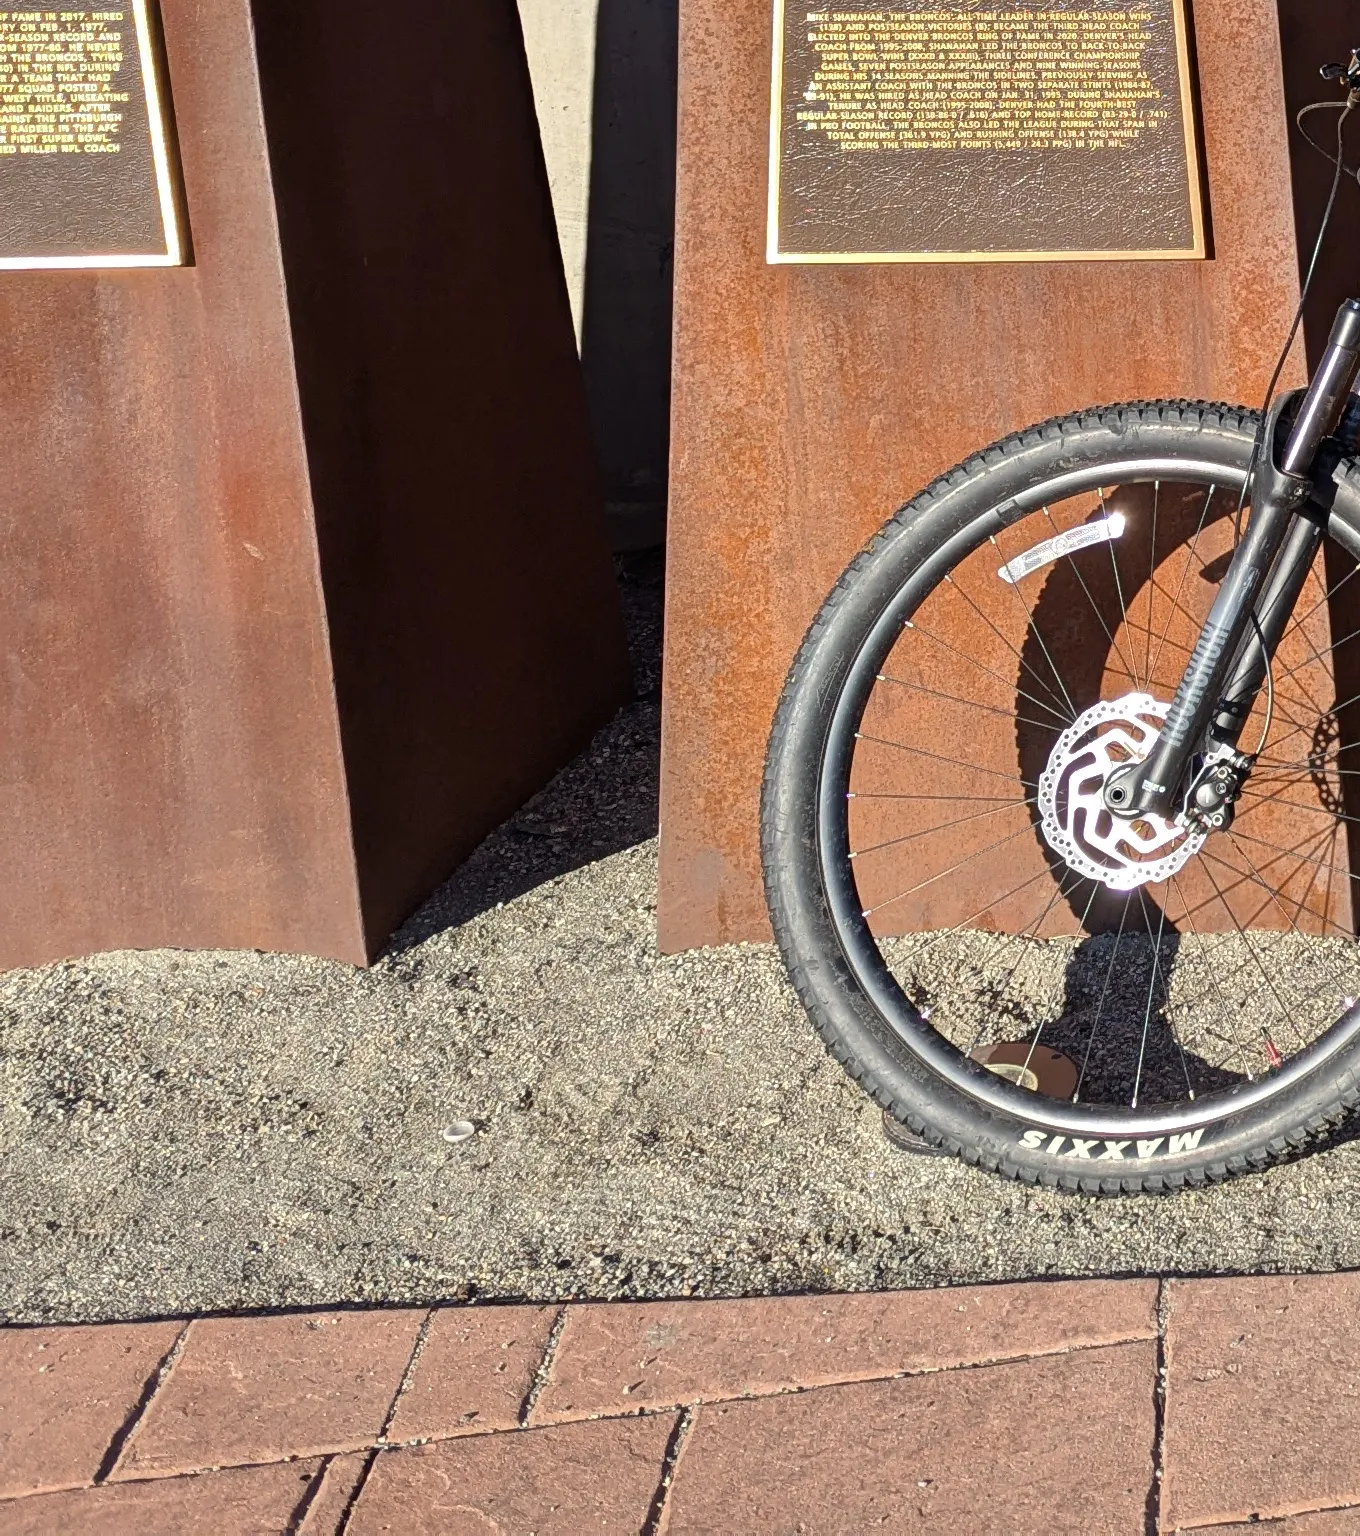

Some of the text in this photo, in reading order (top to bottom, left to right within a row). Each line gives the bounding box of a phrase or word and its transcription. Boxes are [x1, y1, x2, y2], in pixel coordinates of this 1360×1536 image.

[11, 13, 41, 22] FAME
[45, 13, 56, 22] IN
[92, 13, 123, 22] HIRED
[19, 23, 36, 32] ON
[11, 53, 32, 62] THE
[35, 53, 87, 62] BRONCOS,
[91, 53, 123, 62] TYING
[815, 72, 854, 81] DURING
[853, 72, 868, 81] HIS
[871, 72, 881, 80] 14
[885, 72, 924, 80] SEASONS
[927, 72, 970, 80] MANNING
[974, 71, 990, 80] THE
[1041, 70, 1094, 80] PREVIOUSLY
[1097, 70, 1133, 80] SERVING
[1136, 70, 1148, 80] AS
[3, 94, 129, 103] WEST TITLE, UNSEATING
[37, 114, 56, 123] THE
[59, 114, 122, 123] PITTSBURGH
[841, 141, 880, 150] SCORING
[882, 141, 900, 150] THE
[903, 140, 957, 150] THIRD-MOST
[960, 140, 991, 149] POINTS
[1075, 139, 1085, 148] IN
[1089, 139, 1105, 148] THE
[20, 145, 58, 154] MILLER
[61, 145, 81, 154] NFL
[84, 145, 120, 154] COACH
[1160, 620, 1230, 748] ROCKSHOX
[1018, 1128, 1206, 1160] MAXXIS
